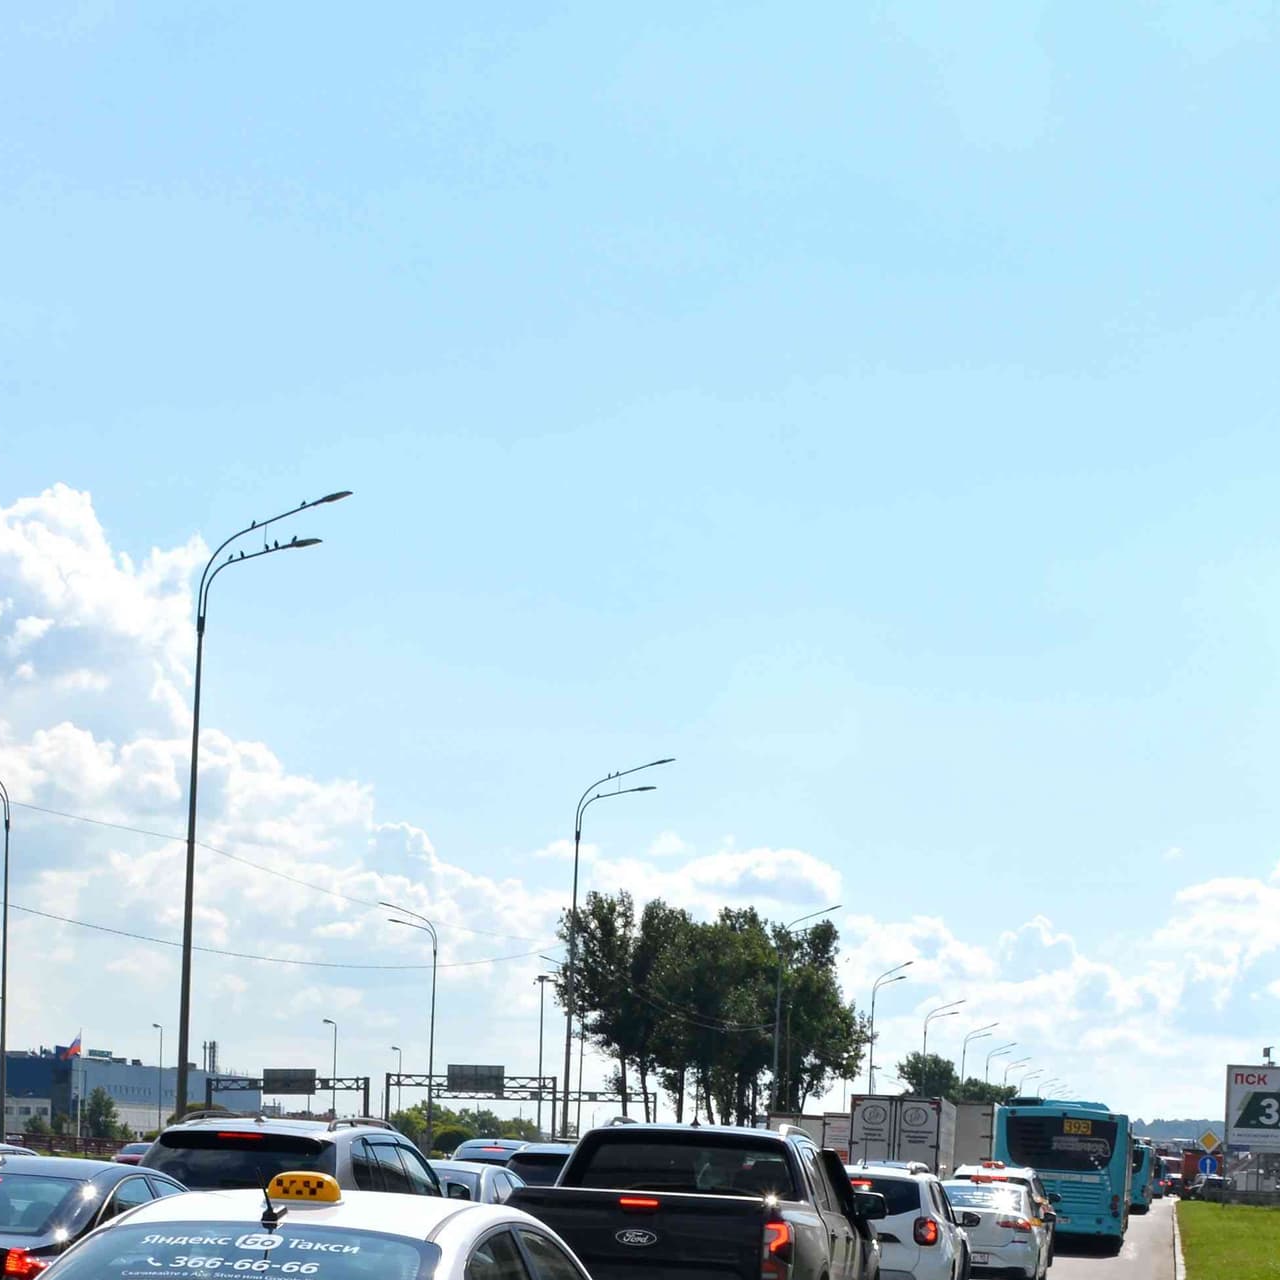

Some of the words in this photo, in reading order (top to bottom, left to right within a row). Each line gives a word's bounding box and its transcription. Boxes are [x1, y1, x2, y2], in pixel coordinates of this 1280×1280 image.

[1234, 1073, 1267, 1086] ПСК
[141, 1234, 233, 1246] Яндекс
[288, 1238, 361, 1254] Такси
[623, 1231, 649, 1243] Ford
[169, 1255, 320, 1274] 366-66-66
